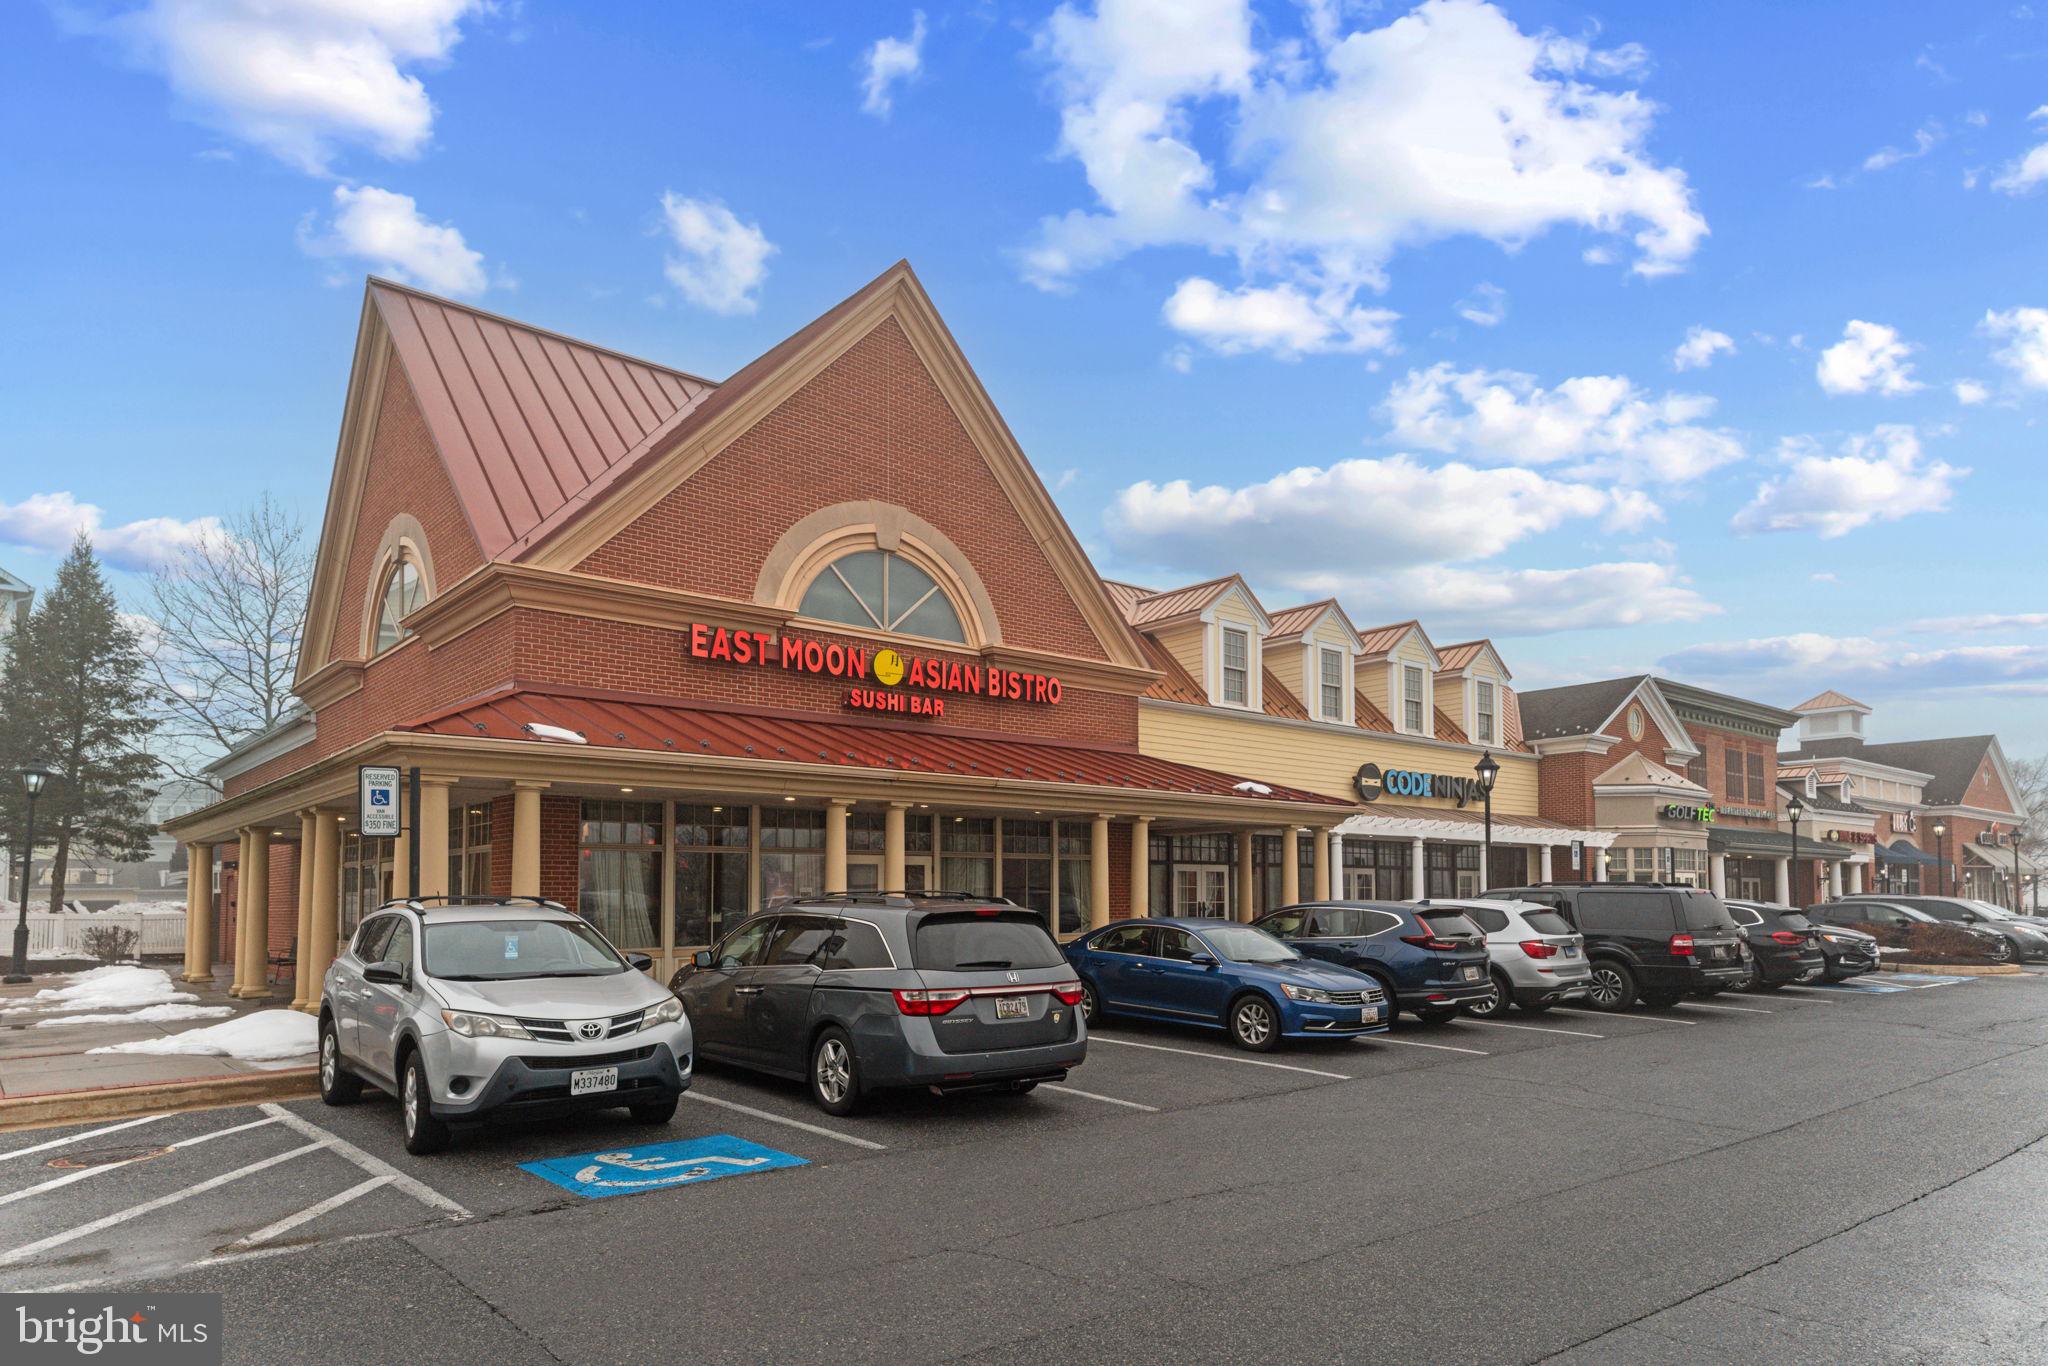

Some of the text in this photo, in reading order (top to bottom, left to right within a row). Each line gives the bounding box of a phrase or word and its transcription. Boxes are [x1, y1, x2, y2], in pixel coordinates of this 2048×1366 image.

[691, 623, 1062, 705] EAST MOON ASIAN BISTRO
[850, 688, 944, 717] SUSHI BAR
[365, 773, 396, 781] RESERVED
[1386, 769, 1433, 797] CODE
[1667, 803, 1715, 822] GOLFTEC
[365, 820, 396, 829] $350 FINE
[574, 1074, 616, 1090] M337480
